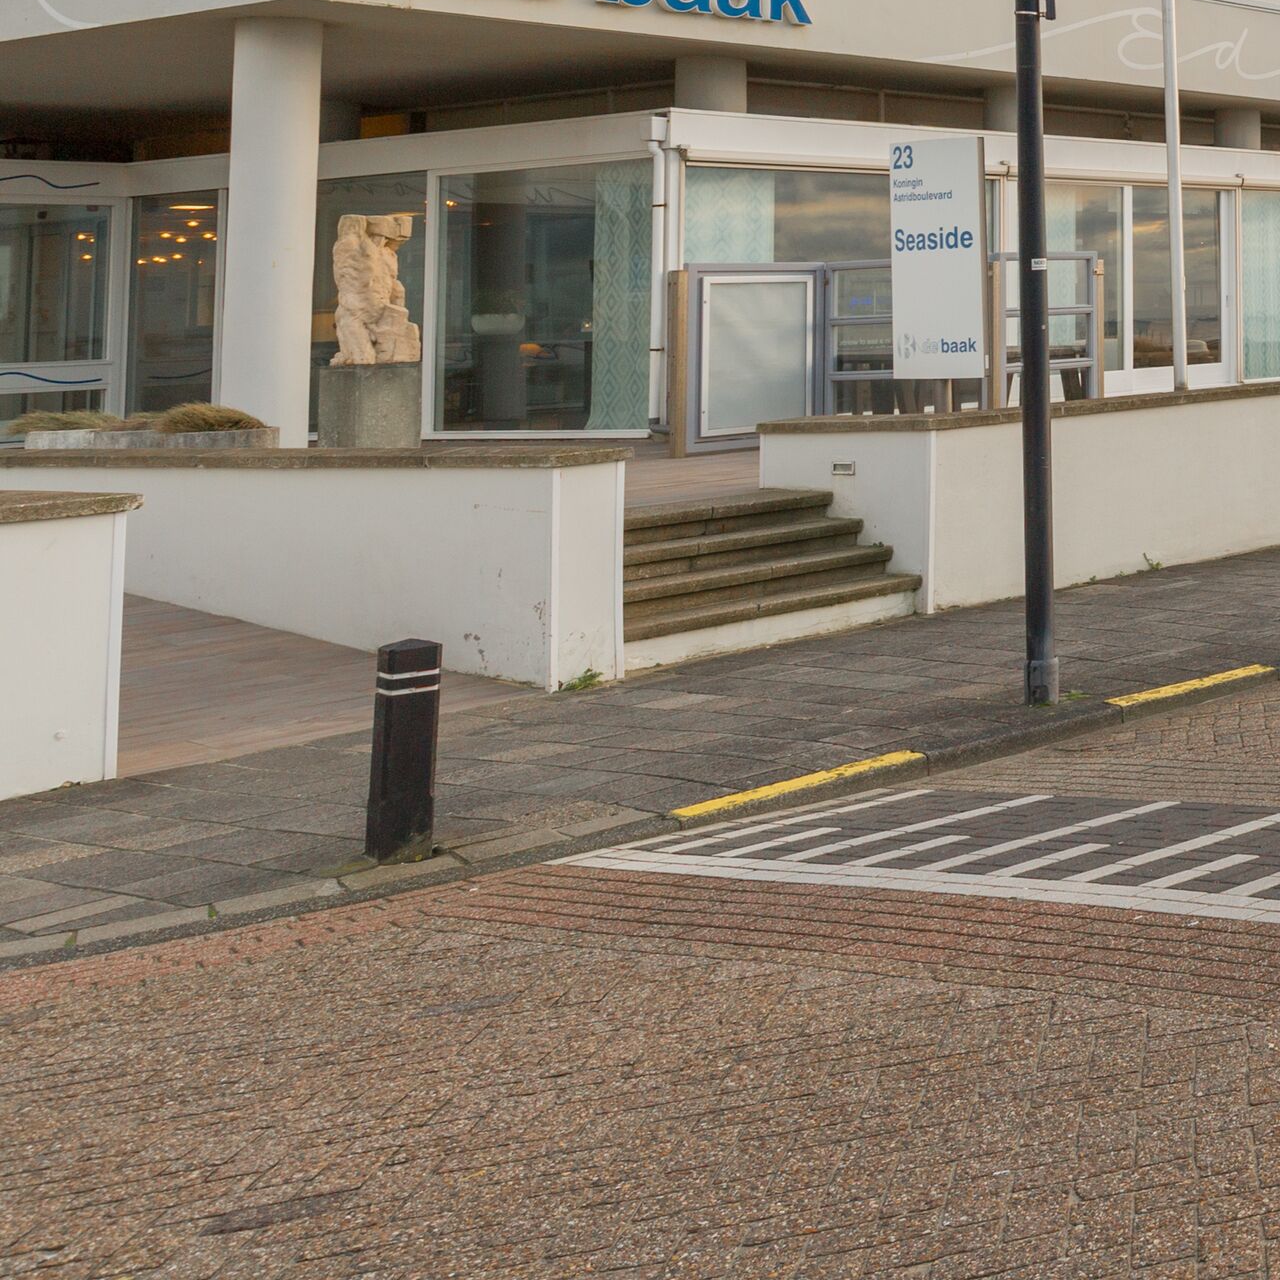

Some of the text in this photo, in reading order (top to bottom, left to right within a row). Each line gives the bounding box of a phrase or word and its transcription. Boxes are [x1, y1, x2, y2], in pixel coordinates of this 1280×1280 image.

[893, 145, 913, 169] 23
[893, 177, 923, 189] Koningin
[893, 190, 953, 202] Astridboulevard
[895, 226, 974, 252] Seaside
[940, 337, 977, 353] baak
